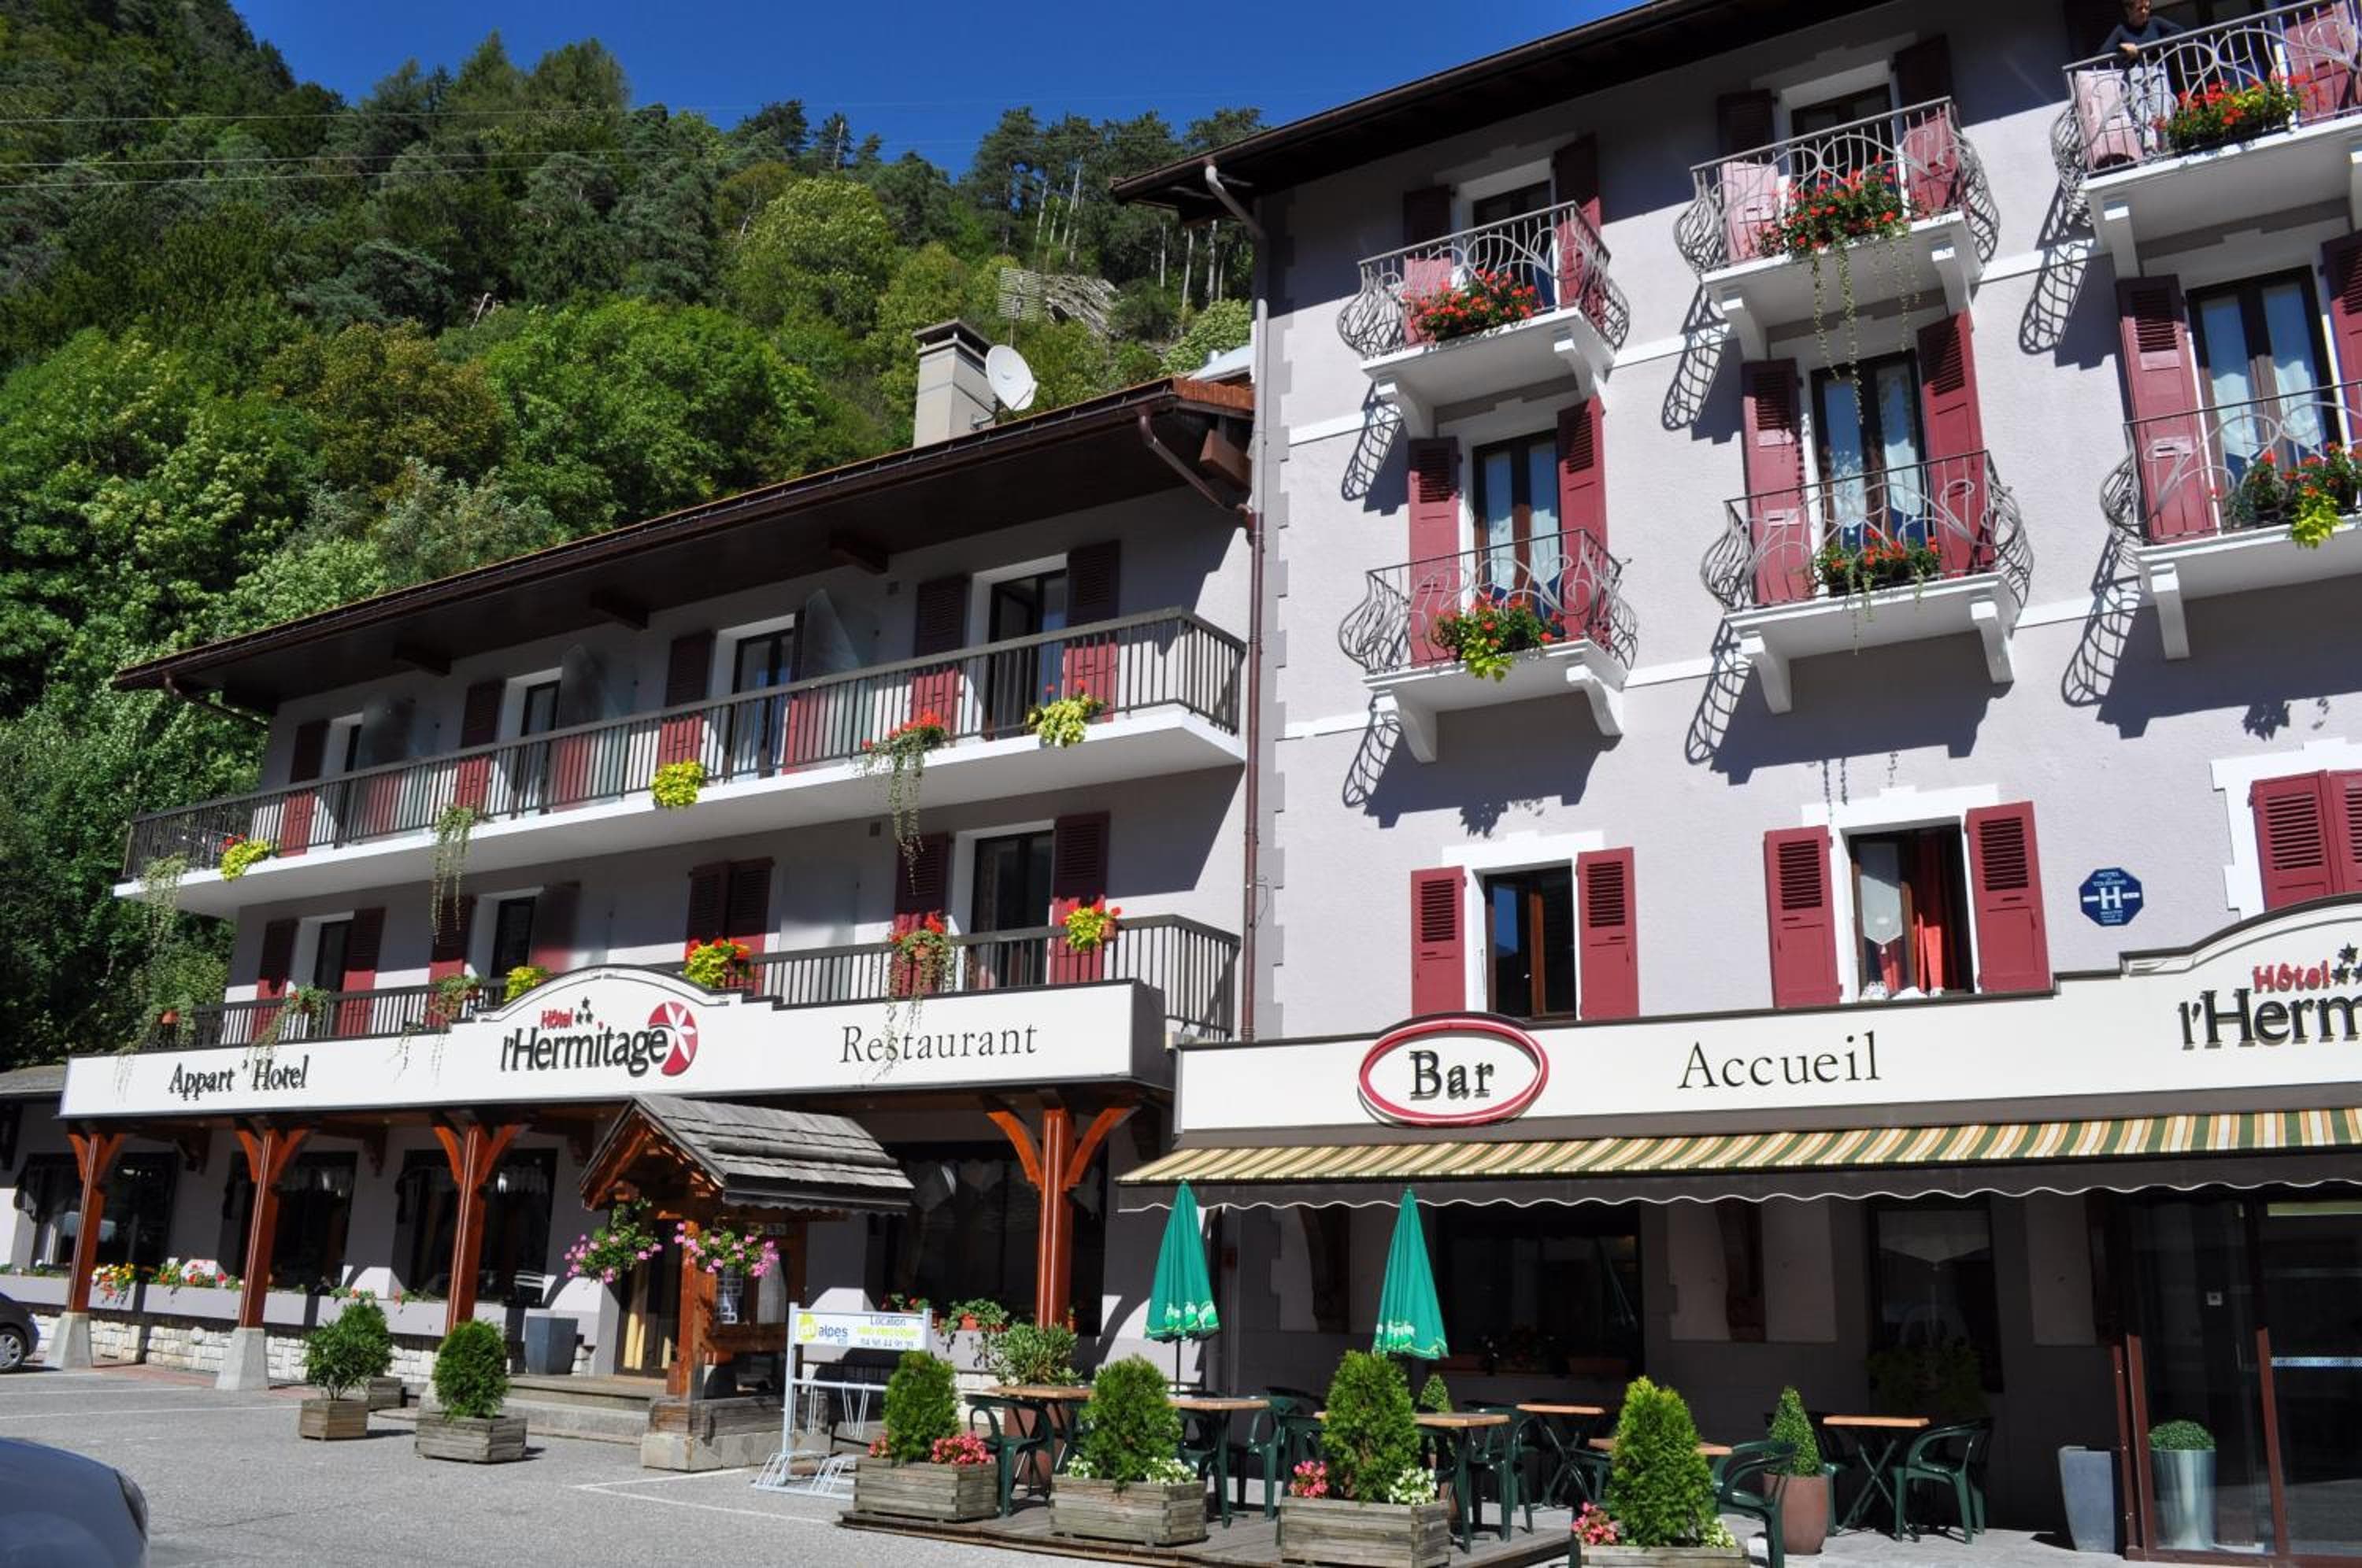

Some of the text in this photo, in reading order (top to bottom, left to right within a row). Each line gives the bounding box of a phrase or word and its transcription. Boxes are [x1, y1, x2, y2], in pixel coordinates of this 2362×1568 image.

[2252, 959, 2331, 994] Hôtel
[540, 1008, 574, 1030] Hôtel
[501, 1022, 668, 1078] l'Hermitage
[839, 1023, 1038, 1064] Restaurant
[1676, 1030, 1882, 1089] Accueil
[1409, 1049, 1494, 1101] Bar
